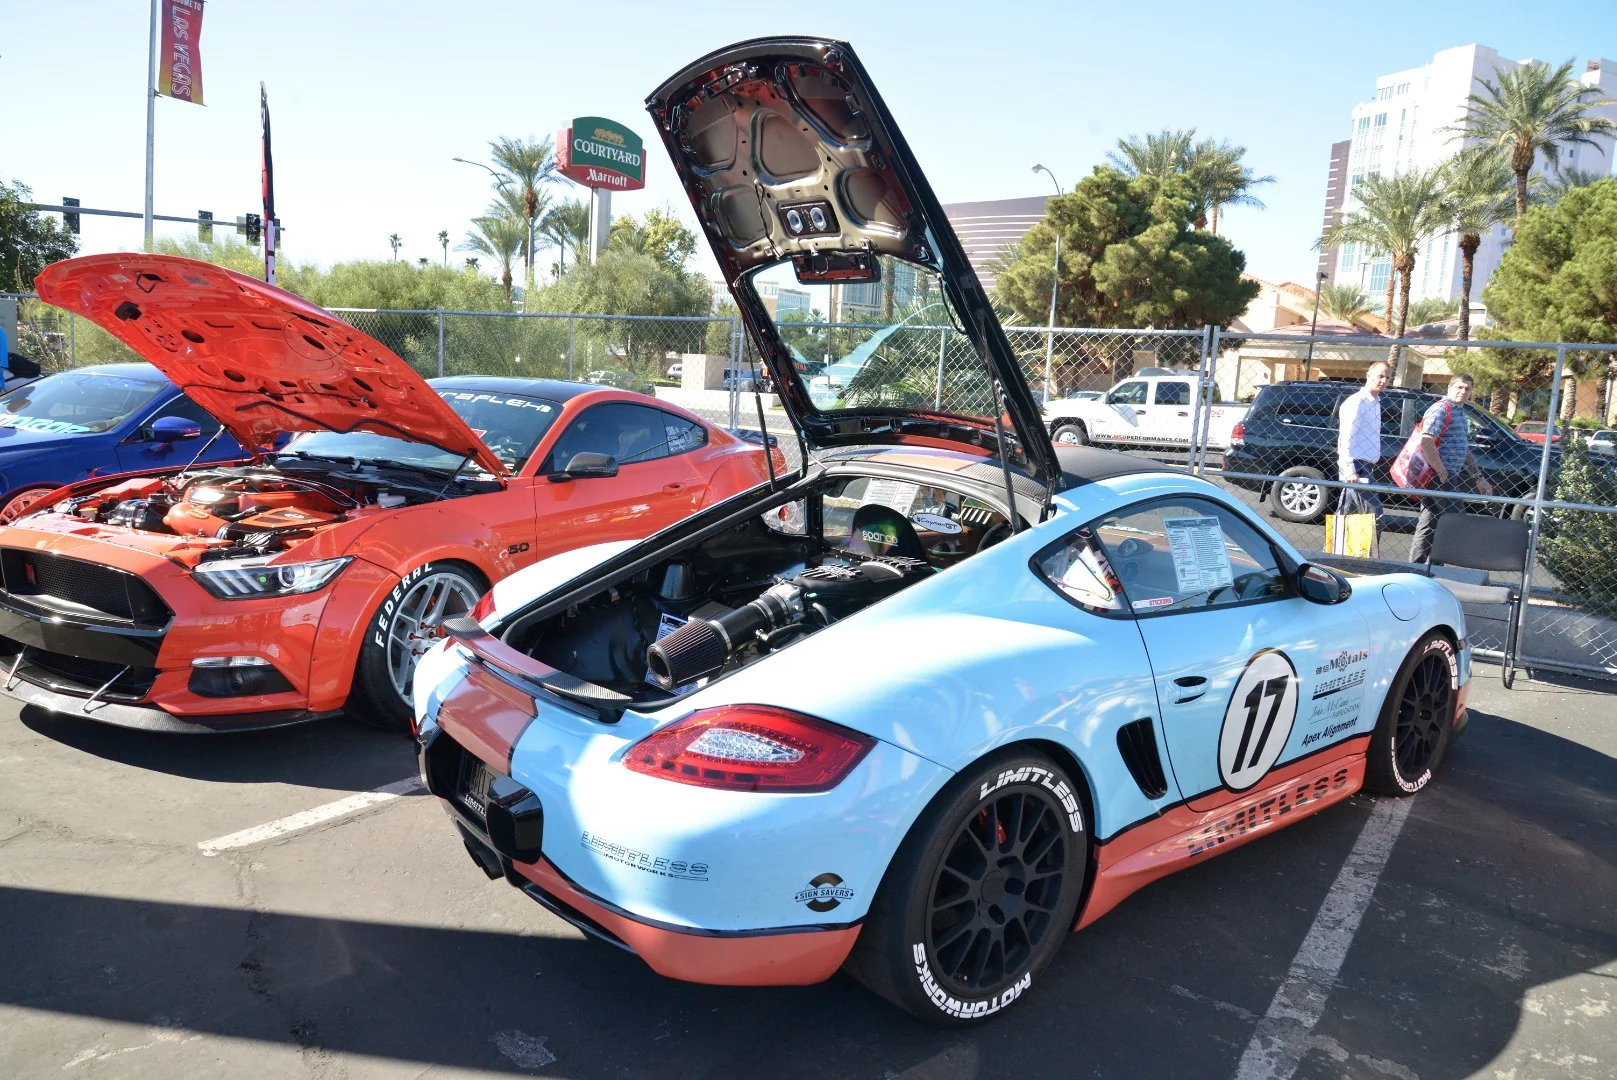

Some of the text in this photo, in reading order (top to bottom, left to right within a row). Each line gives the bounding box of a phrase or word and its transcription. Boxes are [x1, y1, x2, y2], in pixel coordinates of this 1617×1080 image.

[171, 5, 191, 97] LAS VEGAS
[573, 138, 641, 167] COURTYARD
[586, 168, 627, 188] Marriott
[862, 529, 899, 545] sparco
[375, 562, 433, 648] FEDERAL
[1231, 675, 1289, 774] 17
[1301, 716, 1358, 748] Apex Alignment
[979, 766, 1083, 833] LIMITLESS
[581, 830, 709, 876] LIMITLESS
[605, 852, 674, 878] MOTORWORKS
[800, 889, 850, 900] SIGN SAVERS
[913, 942, 1031, 1019] MOTORWORKS
